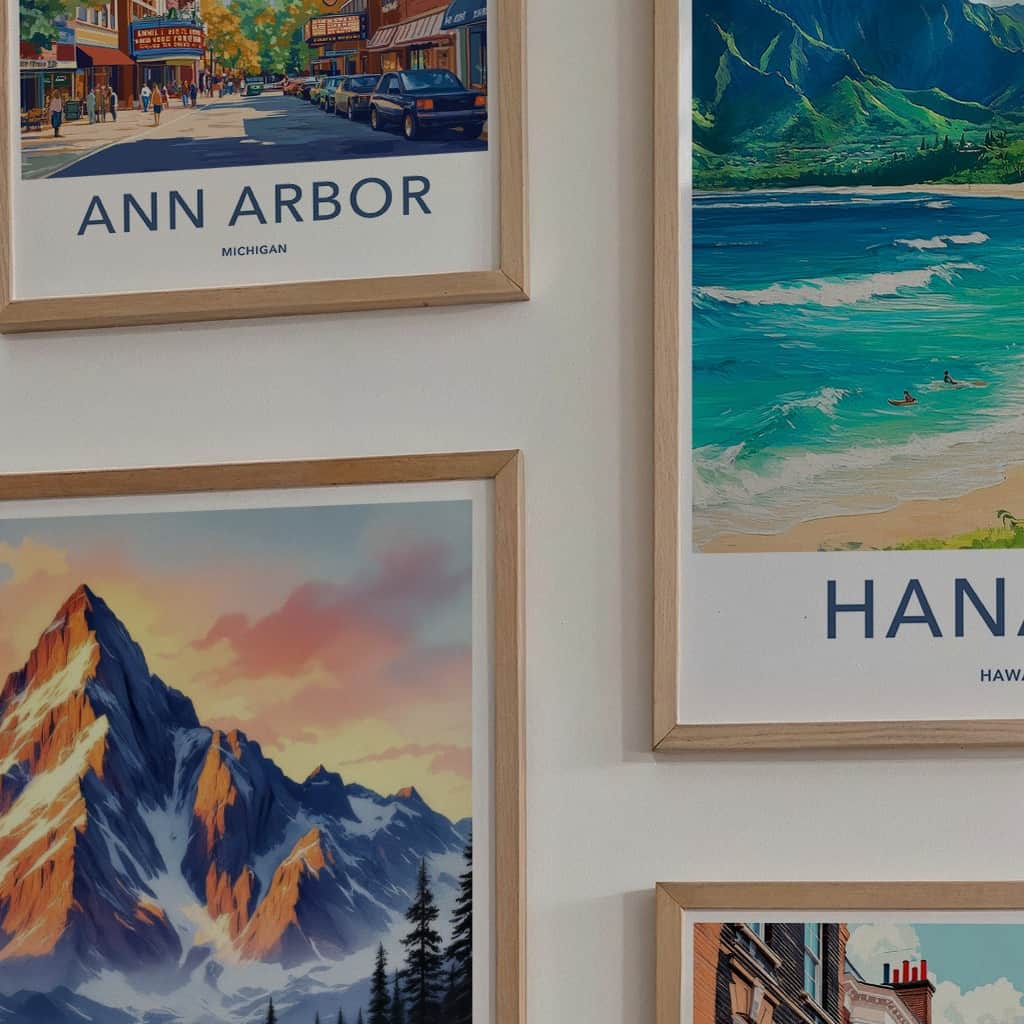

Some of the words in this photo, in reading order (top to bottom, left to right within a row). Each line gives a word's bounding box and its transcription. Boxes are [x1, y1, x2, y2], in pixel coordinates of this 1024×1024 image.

[77, 187, 205, 236] ANN
[228, 175, 433, 228] ARBOR
[221, 243, 288, 257] MICHIGAN
[826, 577, 1024, 640] HAN
